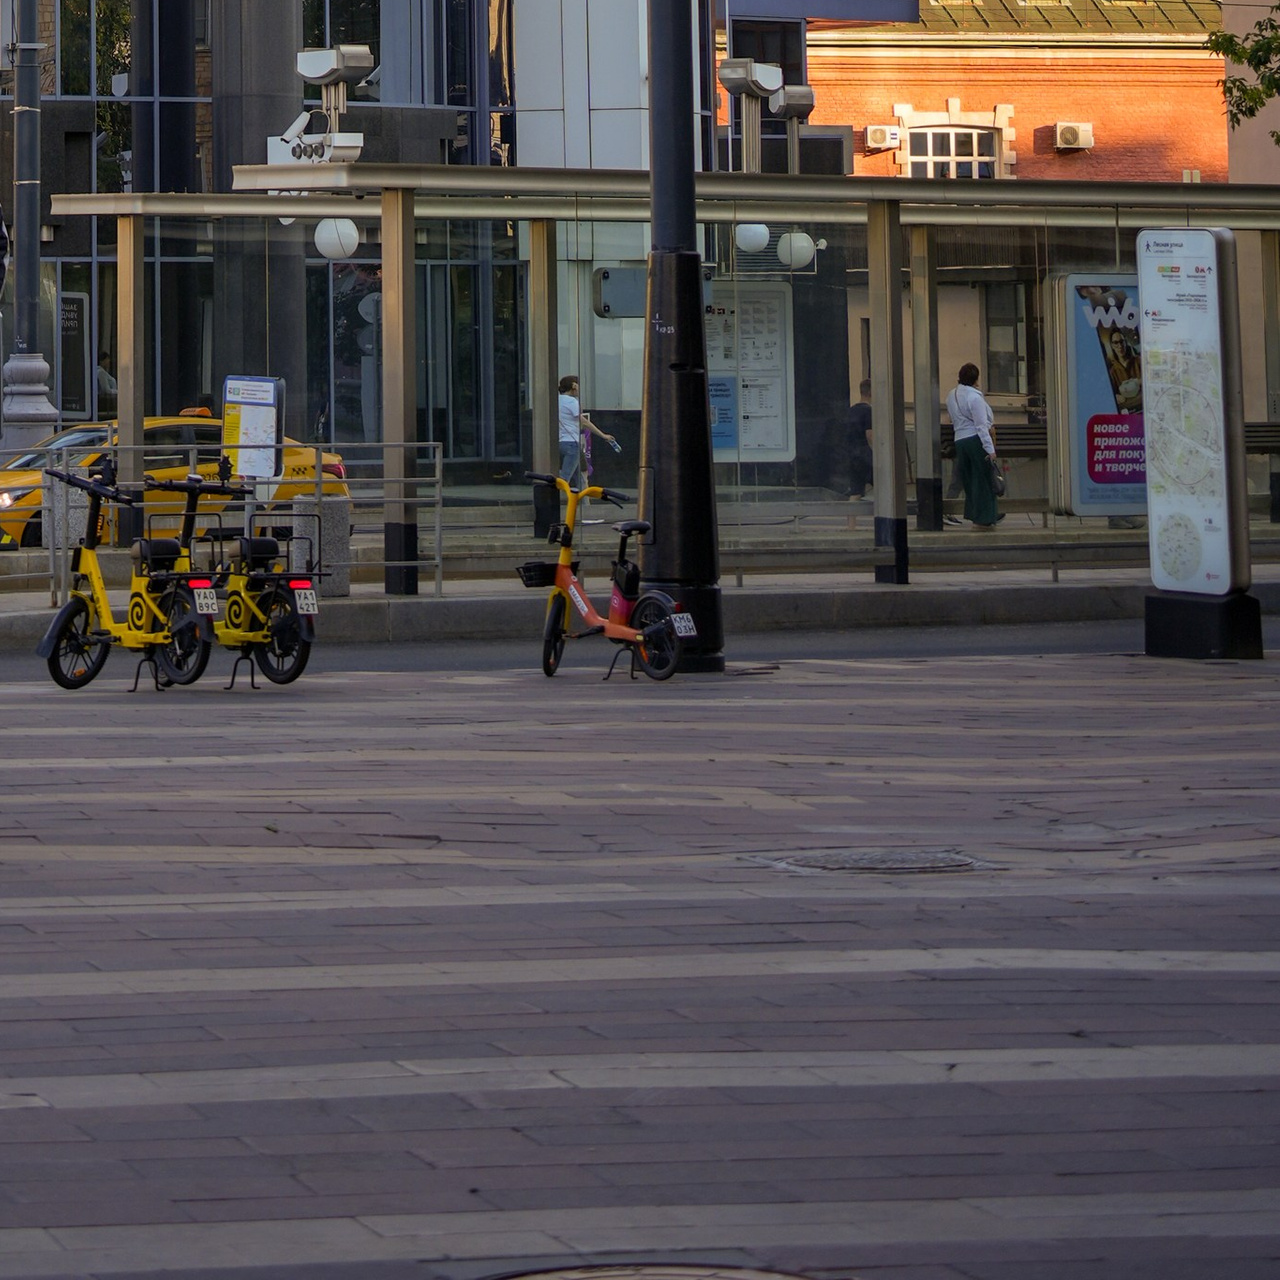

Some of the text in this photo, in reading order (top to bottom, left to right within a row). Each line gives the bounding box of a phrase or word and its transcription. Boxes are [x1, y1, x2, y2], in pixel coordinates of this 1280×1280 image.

[1093, 424, 1130, 433] новое
[1094, 450, 1116, 461] для
[1094, 463, 1103, 472] и
